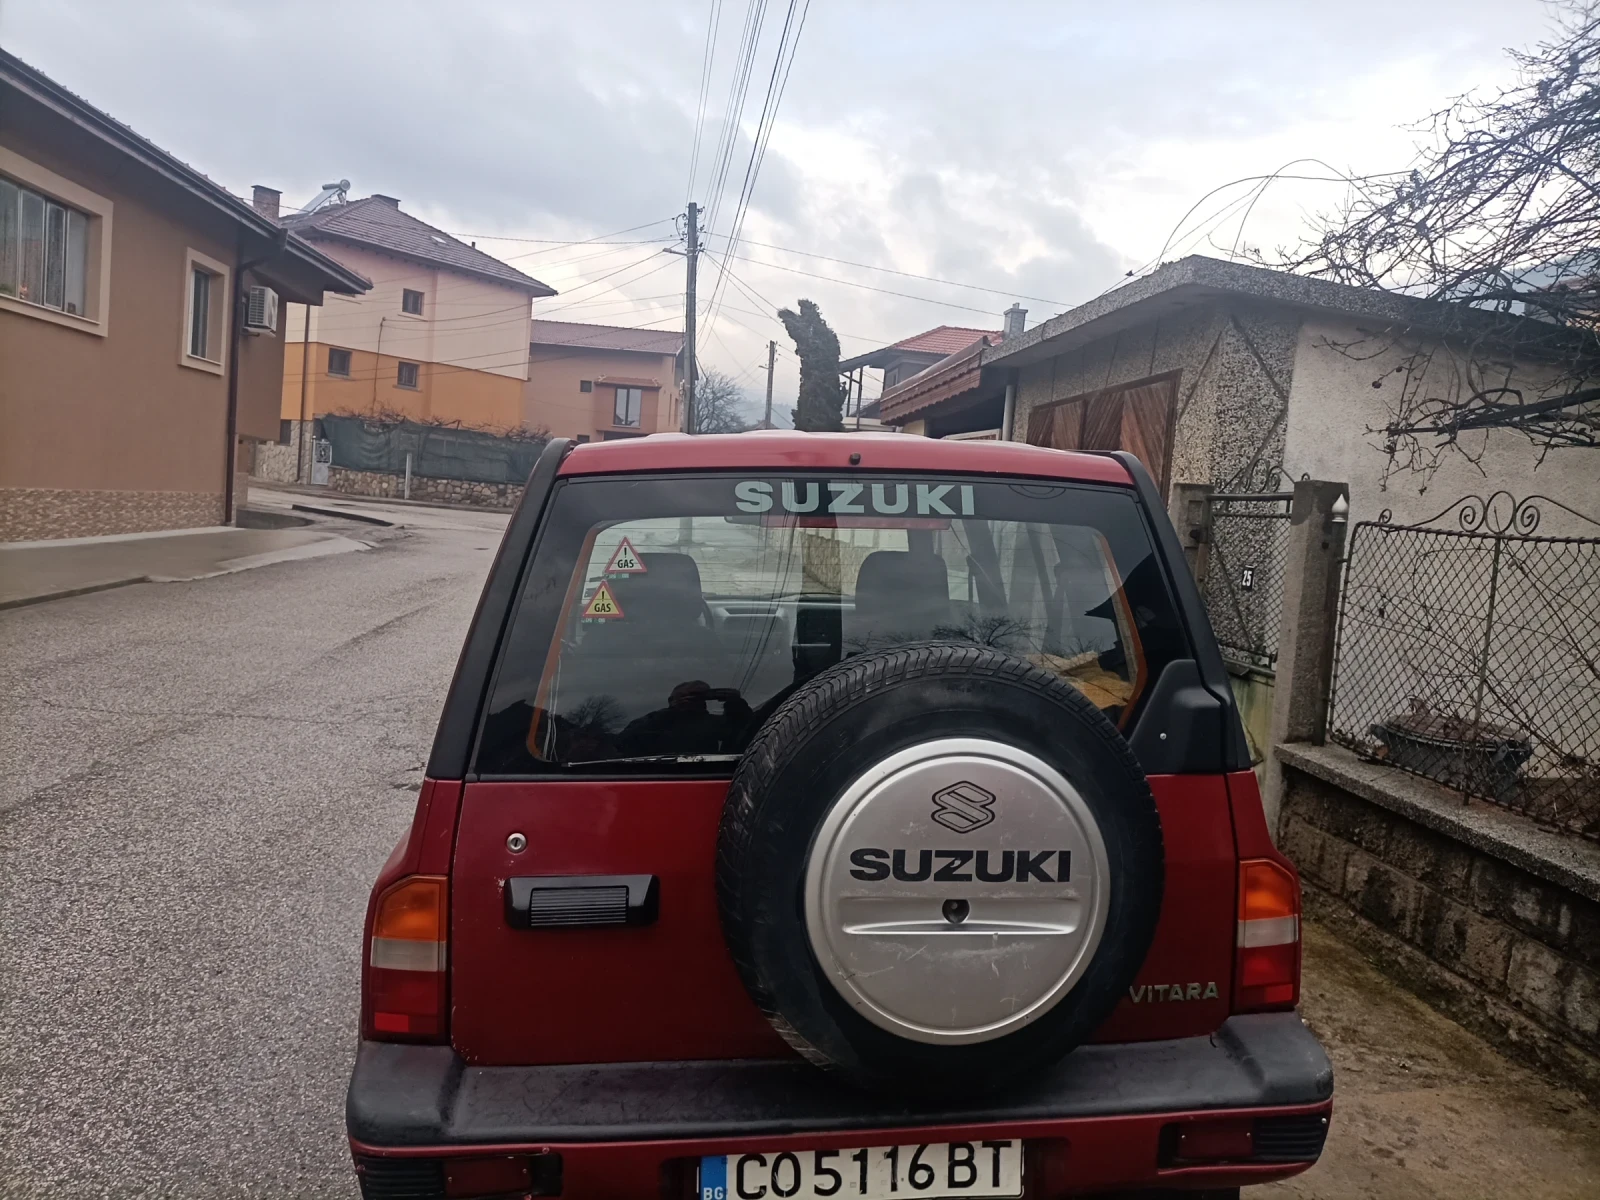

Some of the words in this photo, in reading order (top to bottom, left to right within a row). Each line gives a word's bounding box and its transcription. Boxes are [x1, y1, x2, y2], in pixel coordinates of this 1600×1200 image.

[734, 480, 975, 516] SUZUKI
[617, 559, 634, 569] GAS
[1242, 570, 1252, 586] 25
[594, 603, 611, 613] GAS
[849, 848, 1072, 883] SUZUKI
[1128, 981, 1219, 1004] VITARA
[703, 1186, 724, 1200] BG
